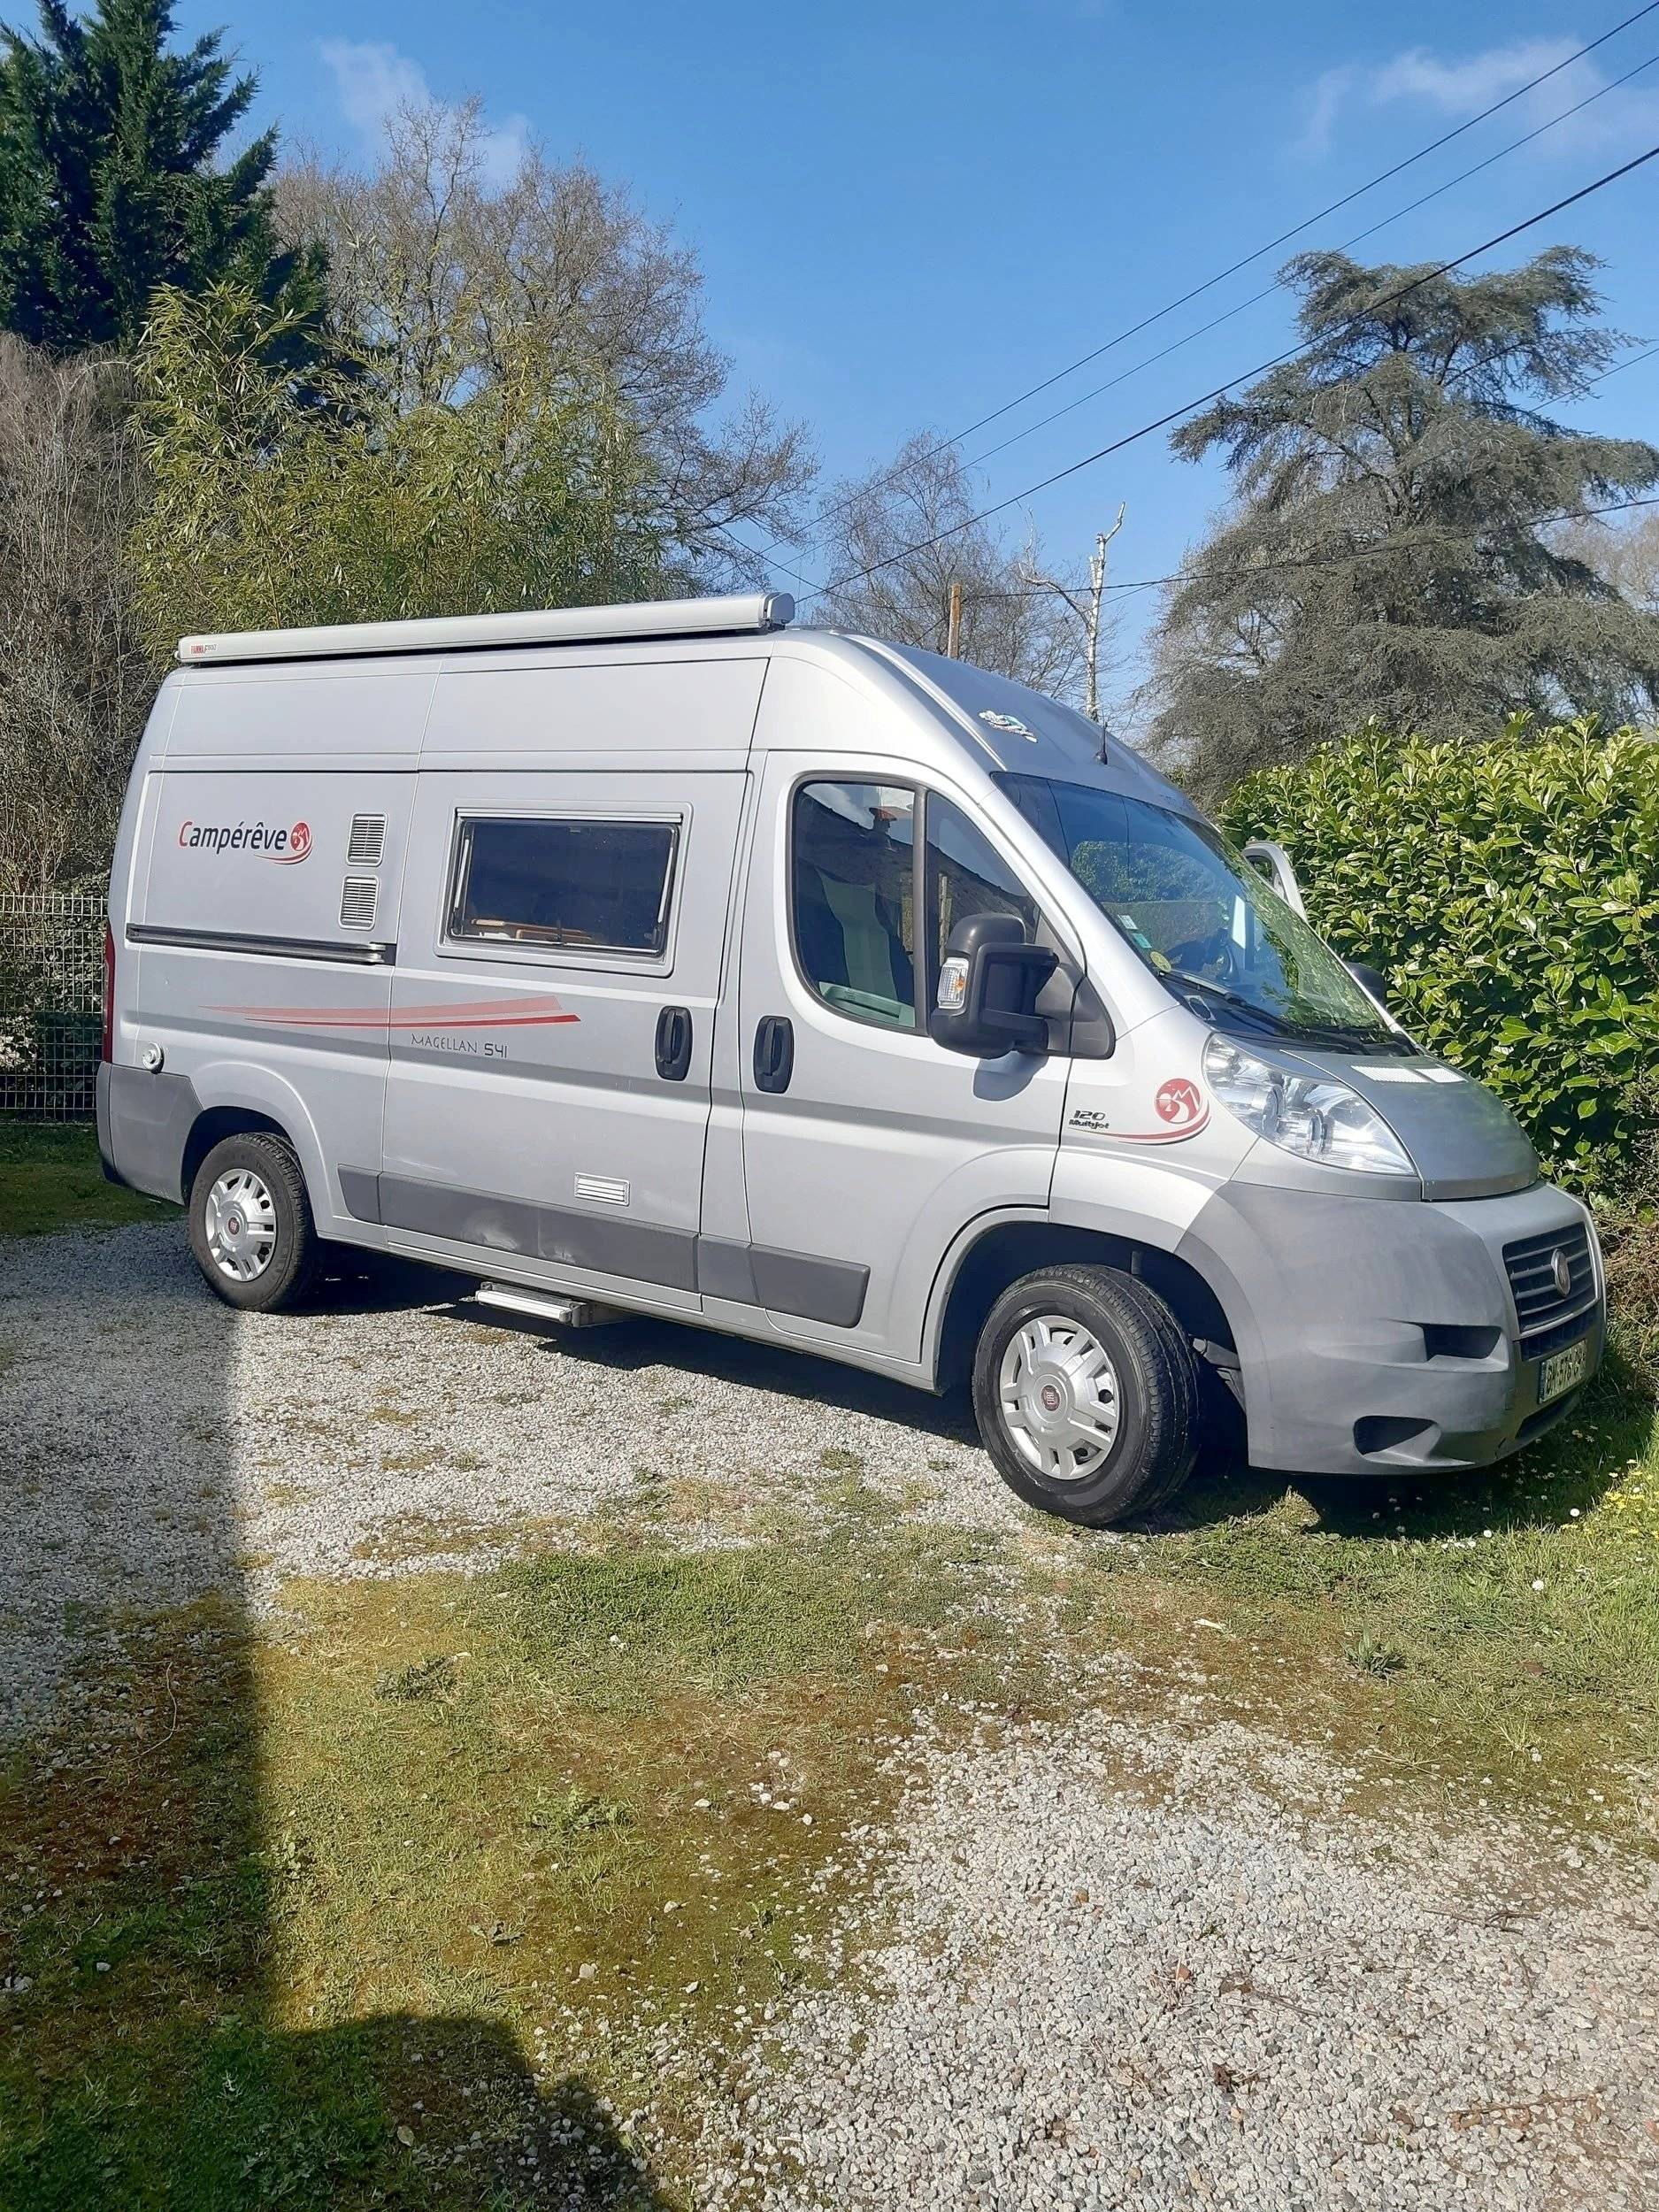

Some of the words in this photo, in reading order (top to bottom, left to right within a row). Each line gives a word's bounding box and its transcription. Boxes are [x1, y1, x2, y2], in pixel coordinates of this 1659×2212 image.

[179, 820, 288, 855] Campérêve
[411, 1033, 478, 1054] MAGELLAN
[484, 1042, 508, 1059] 541
[1073, 1110, 1106, 1121] 120
